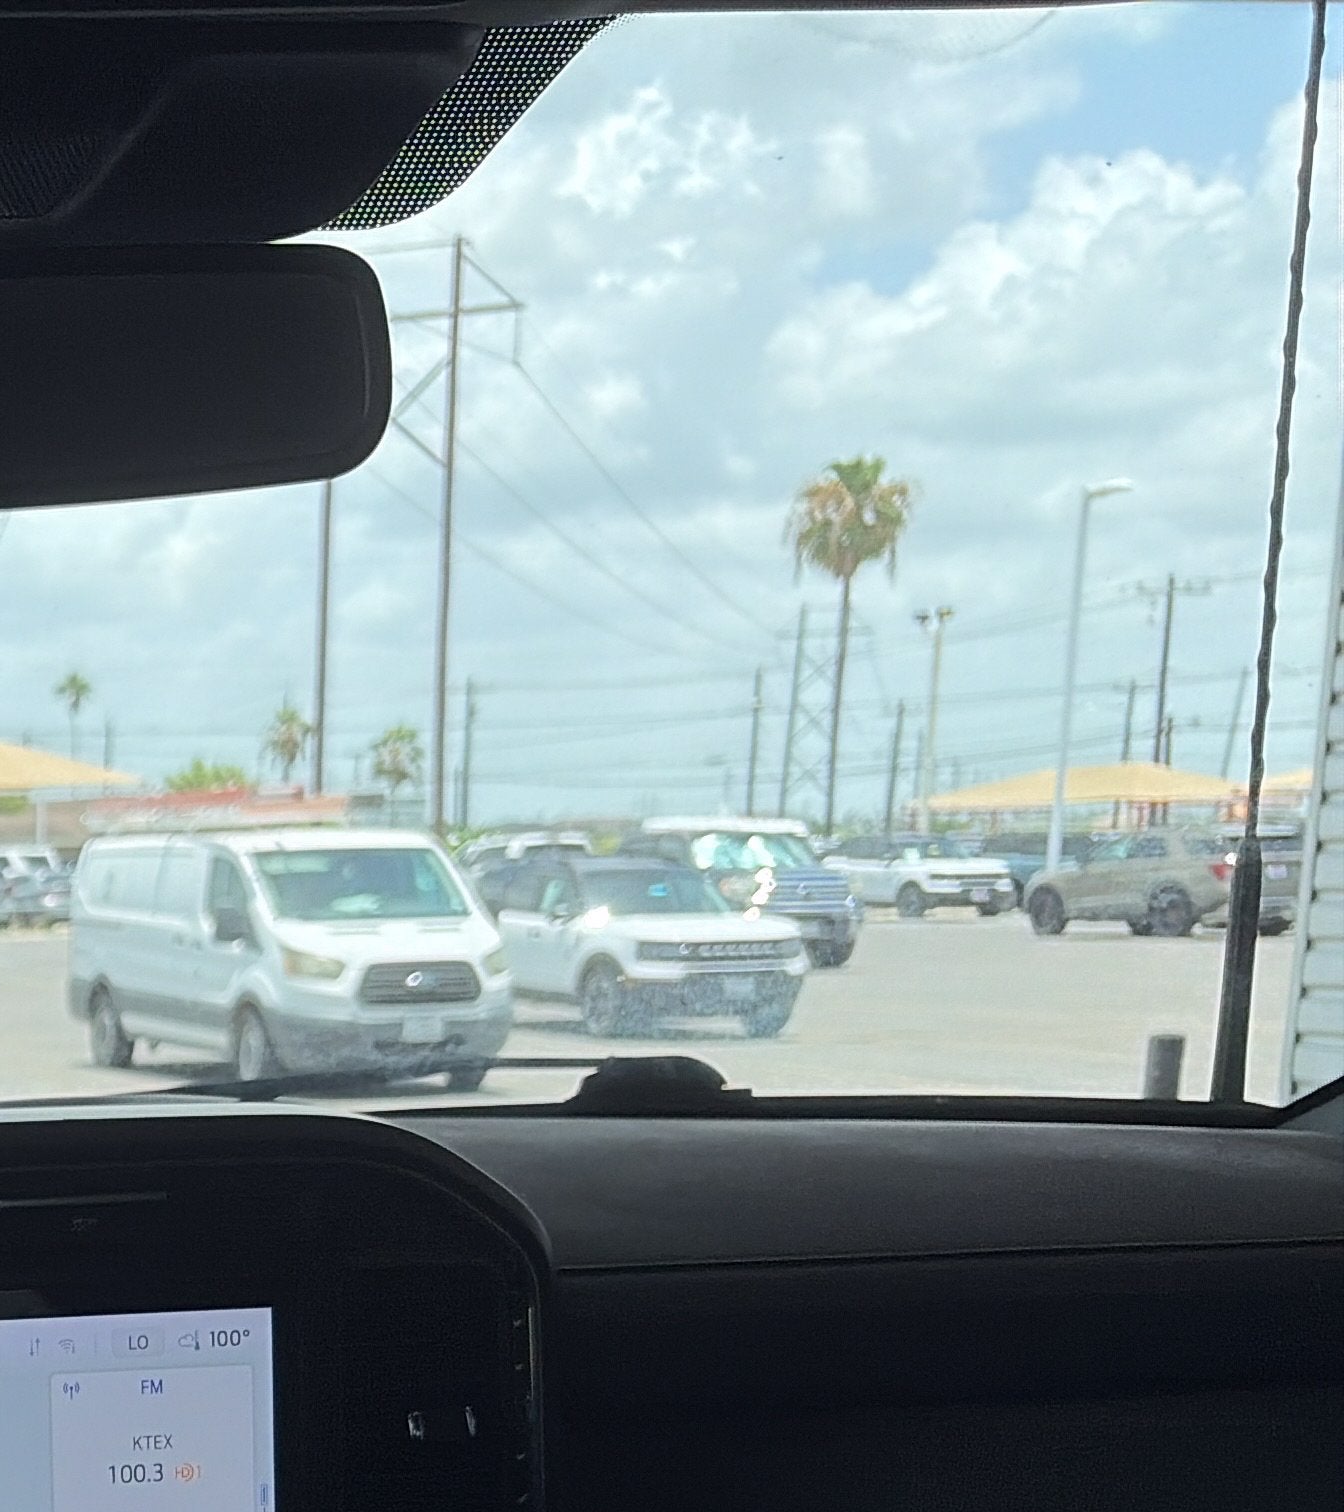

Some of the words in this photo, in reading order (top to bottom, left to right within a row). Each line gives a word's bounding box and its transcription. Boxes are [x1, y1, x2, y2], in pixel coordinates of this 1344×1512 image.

[127, 1335, 150, 1351] LO
[208, 1329, 251, 1349] 100°
[140, 1379, 164, 1395] FM
[132, 1434, 174, 1451] KTEX
[108, 1463, 164, 1485] 100.3
